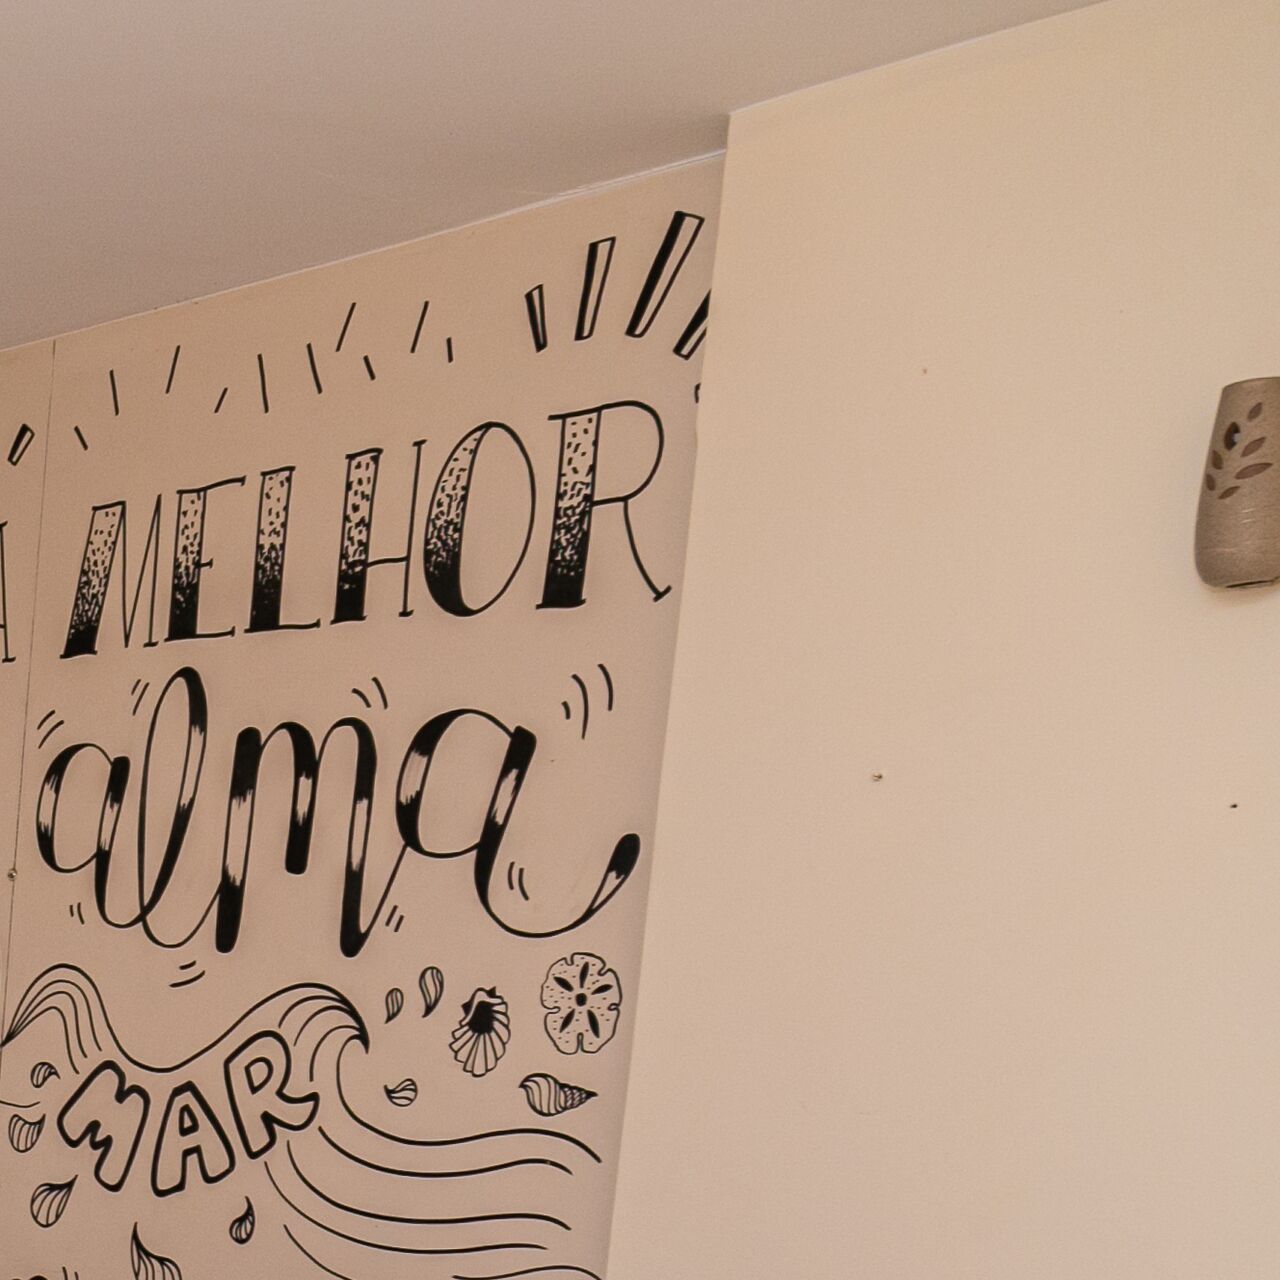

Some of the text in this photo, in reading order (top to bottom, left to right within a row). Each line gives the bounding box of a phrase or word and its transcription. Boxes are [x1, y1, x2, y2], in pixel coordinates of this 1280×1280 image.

[59, 400, 672, 659] MELHOR
[36, 666, 641, 958] alma
[56, 1029, 321, 1198] MAR
